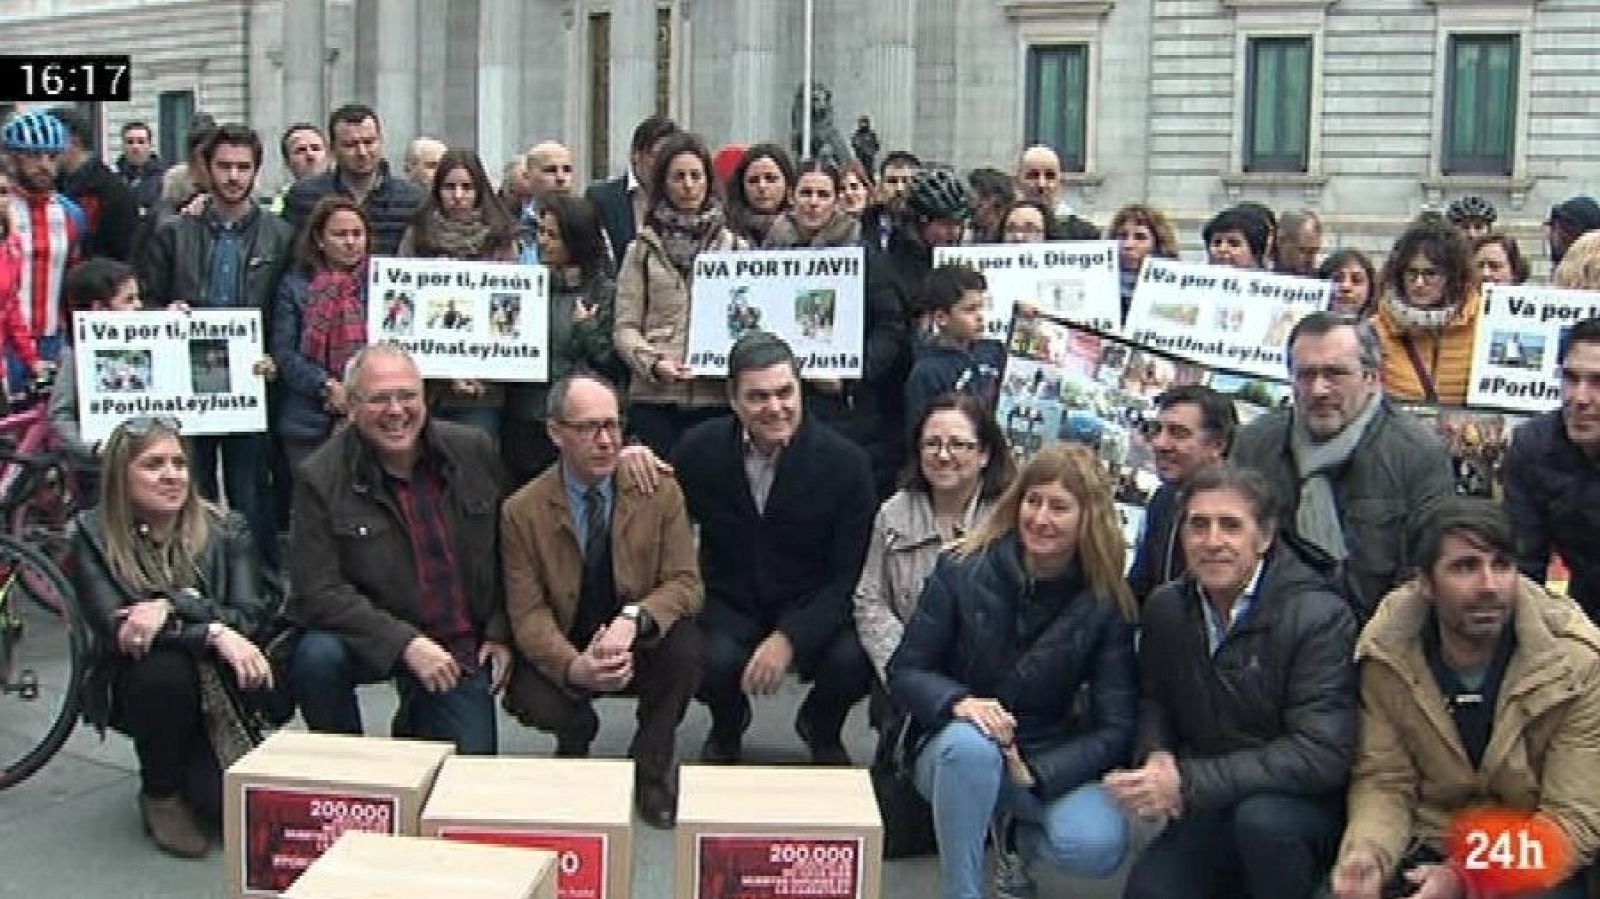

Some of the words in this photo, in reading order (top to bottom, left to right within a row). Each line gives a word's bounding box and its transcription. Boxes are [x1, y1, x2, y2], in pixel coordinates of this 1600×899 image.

[736, 260, 778, 276] POR
[783, 260, 799, 276] TI
[1044, 249, 1113, 271] Diego!
[386, 268, 412, 283] Va
[416, 274, 451, 289] por
[1181, 274, 1216, 290] por
[1507, 296, 1536, 317] Va
[1541, 304, 1582, 323] por
[92, 321, 119, 340] Va
[125, 324, 160, 343] por
